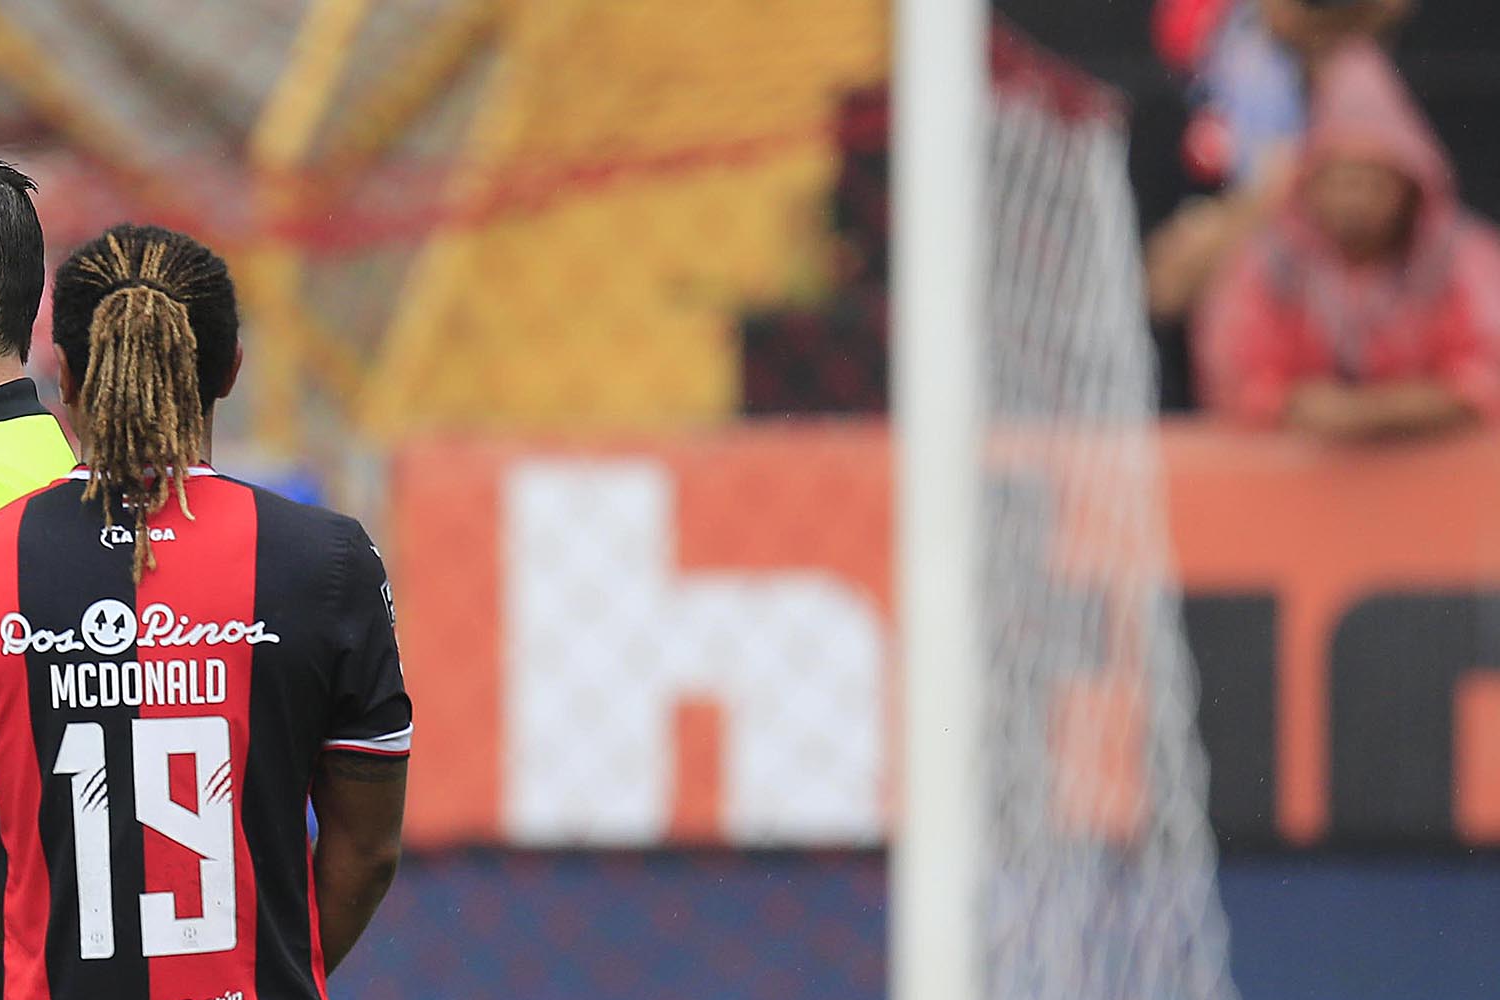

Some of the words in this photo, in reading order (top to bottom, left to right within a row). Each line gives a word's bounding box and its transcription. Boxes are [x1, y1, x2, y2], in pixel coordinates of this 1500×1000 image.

[0, 612, 85, 656] Dos
[136, 603, 281, 647] Pinos
[50, 658, 227, 710] MCDONALD
[52, 716, 237, 960] 19
